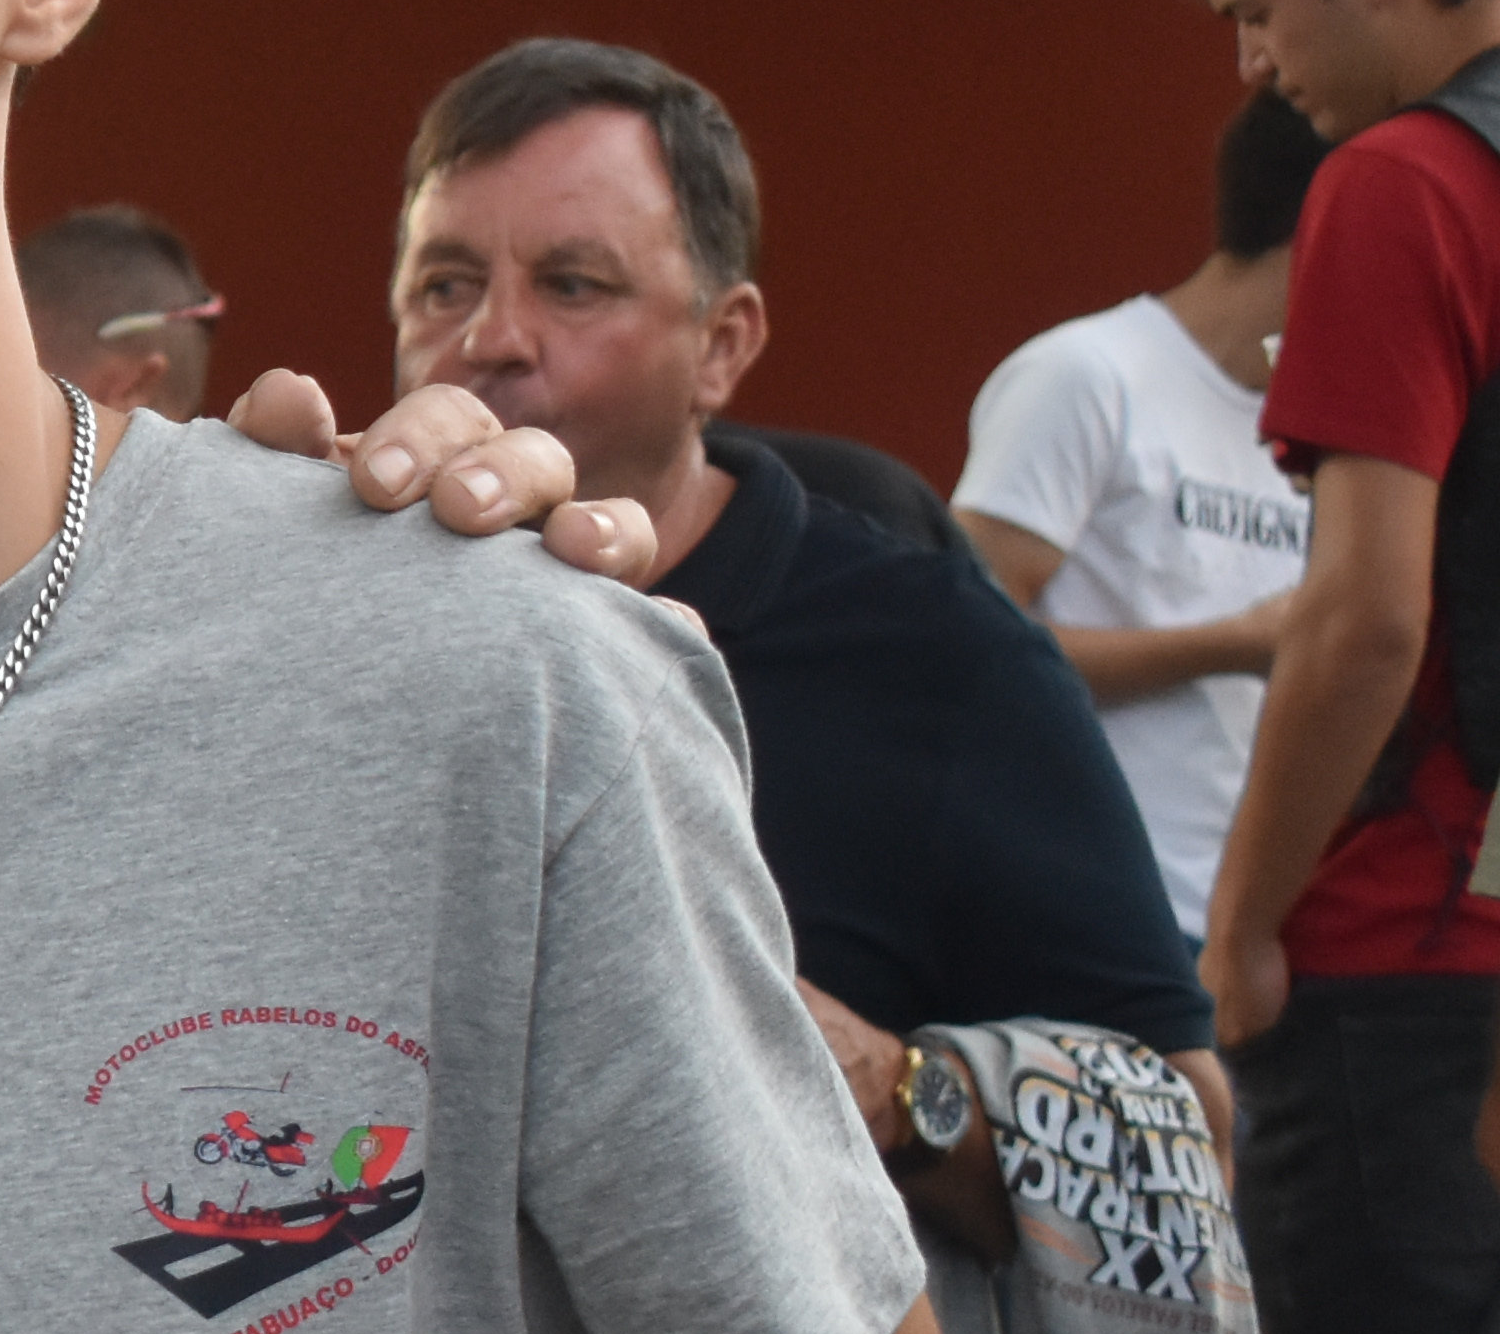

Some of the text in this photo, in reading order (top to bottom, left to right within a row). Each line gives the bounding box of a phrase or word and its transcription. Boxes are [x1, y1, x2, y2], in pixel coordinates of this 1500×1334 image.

[84, 1006, 430, 1106] MOTOCLUBE RABELOS DO ASFA
[375, 1227, 422, 1276] DOU
